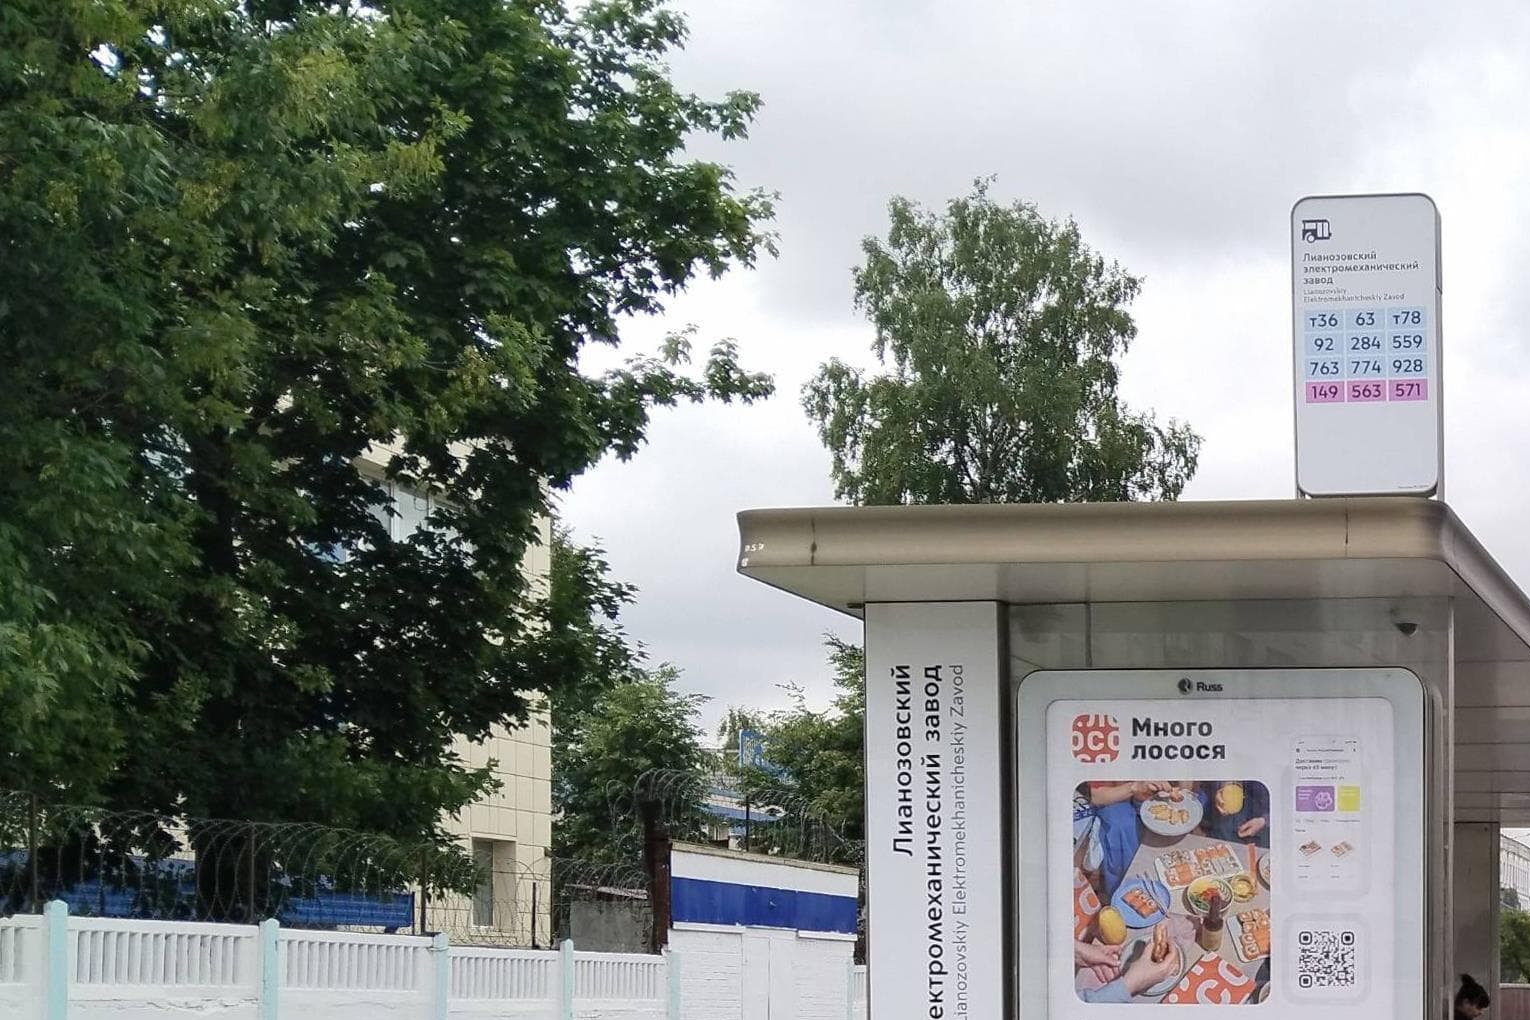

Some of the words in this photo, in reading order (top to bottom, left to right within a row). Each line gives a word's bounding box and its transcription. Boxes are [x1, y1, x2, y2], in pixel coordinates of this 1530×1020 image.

[1303, 250, 1377, 262] Лианозовский
[1303, 261, 1420, 274] электромеханический
[1303, 276, 1334, 285] завод
[1309, 314, 1339, 329] т36
[1355, 312, 1376, 327] 63
[1392, 310, 1422, 326] т78
[1313, 337, 1335, 352] 92
[1350, 336, 1381, 351] 284
[1392, 335, 1423, 350] 559
[1309, 361, 1340, 376] 763
[1351, 360, 1382, 375] 774
[1392, 359, 1424, 373] 928
[1311, 384, 1339, 400] 149
[1351, 384, 1382, 399] 563
[1394, 383, 1422, 398] 571
[949, 664, 966, 717] Zavod
[1196, 681, 1224, 692] Russ
[923, 664, 943, 742] завод
[1131, 717, 1213, 738] Много
[890, 664, 913, 857] Лианозовский
[1130, 744, 1226, 761] лосося
[949, 723, 969, 915] Elektromekhanicheskiy
